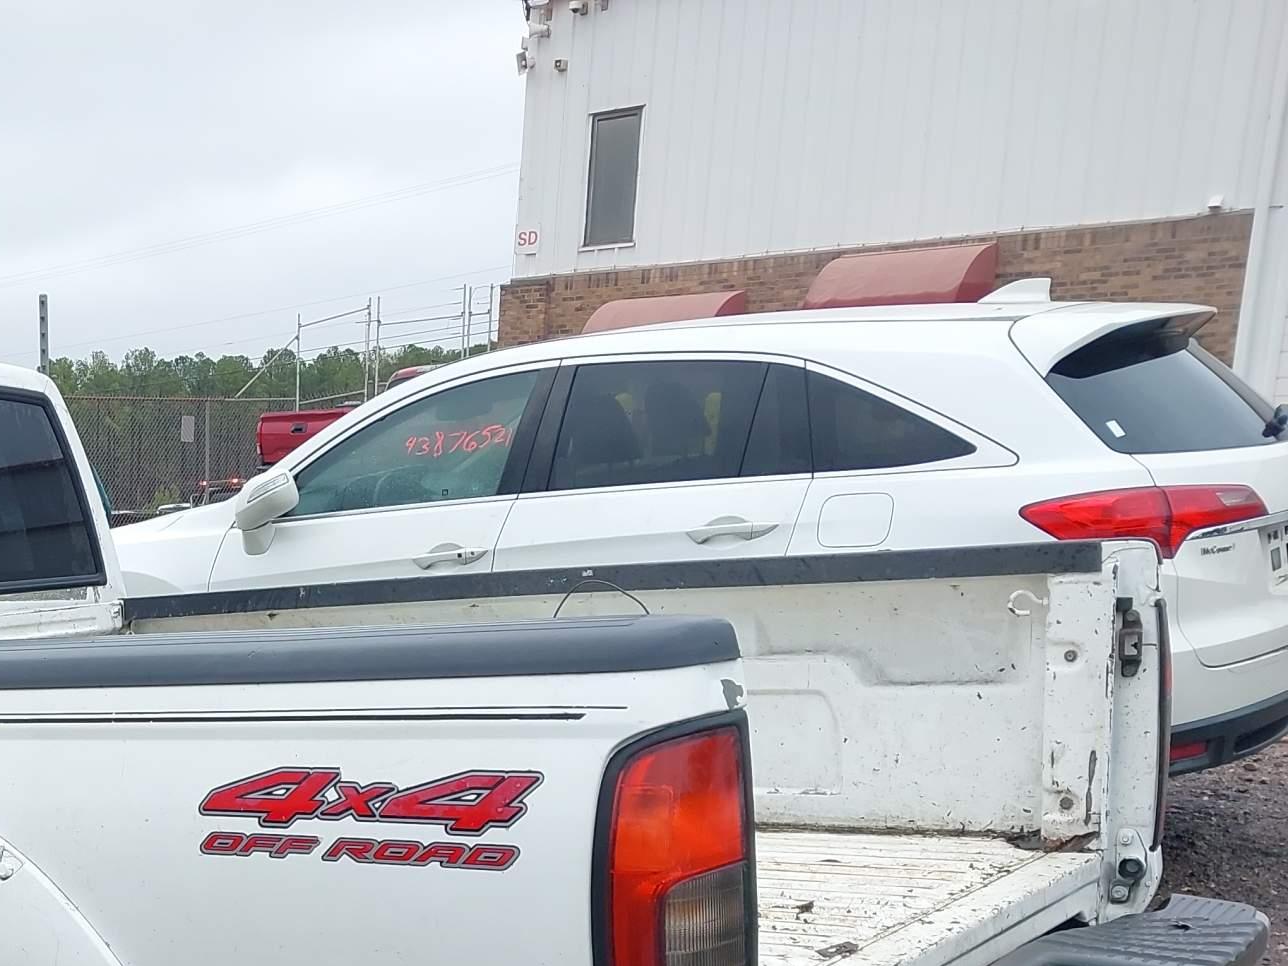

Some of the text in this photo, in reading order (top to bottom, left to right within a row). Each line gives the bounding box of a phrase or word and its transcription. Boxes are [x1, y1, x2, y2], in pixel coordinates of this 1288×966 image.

[518, 231, 538, 246] SD
[199, 767, 544, 836] 4x4
[200, 831, 520, 871] OFF ROAD
